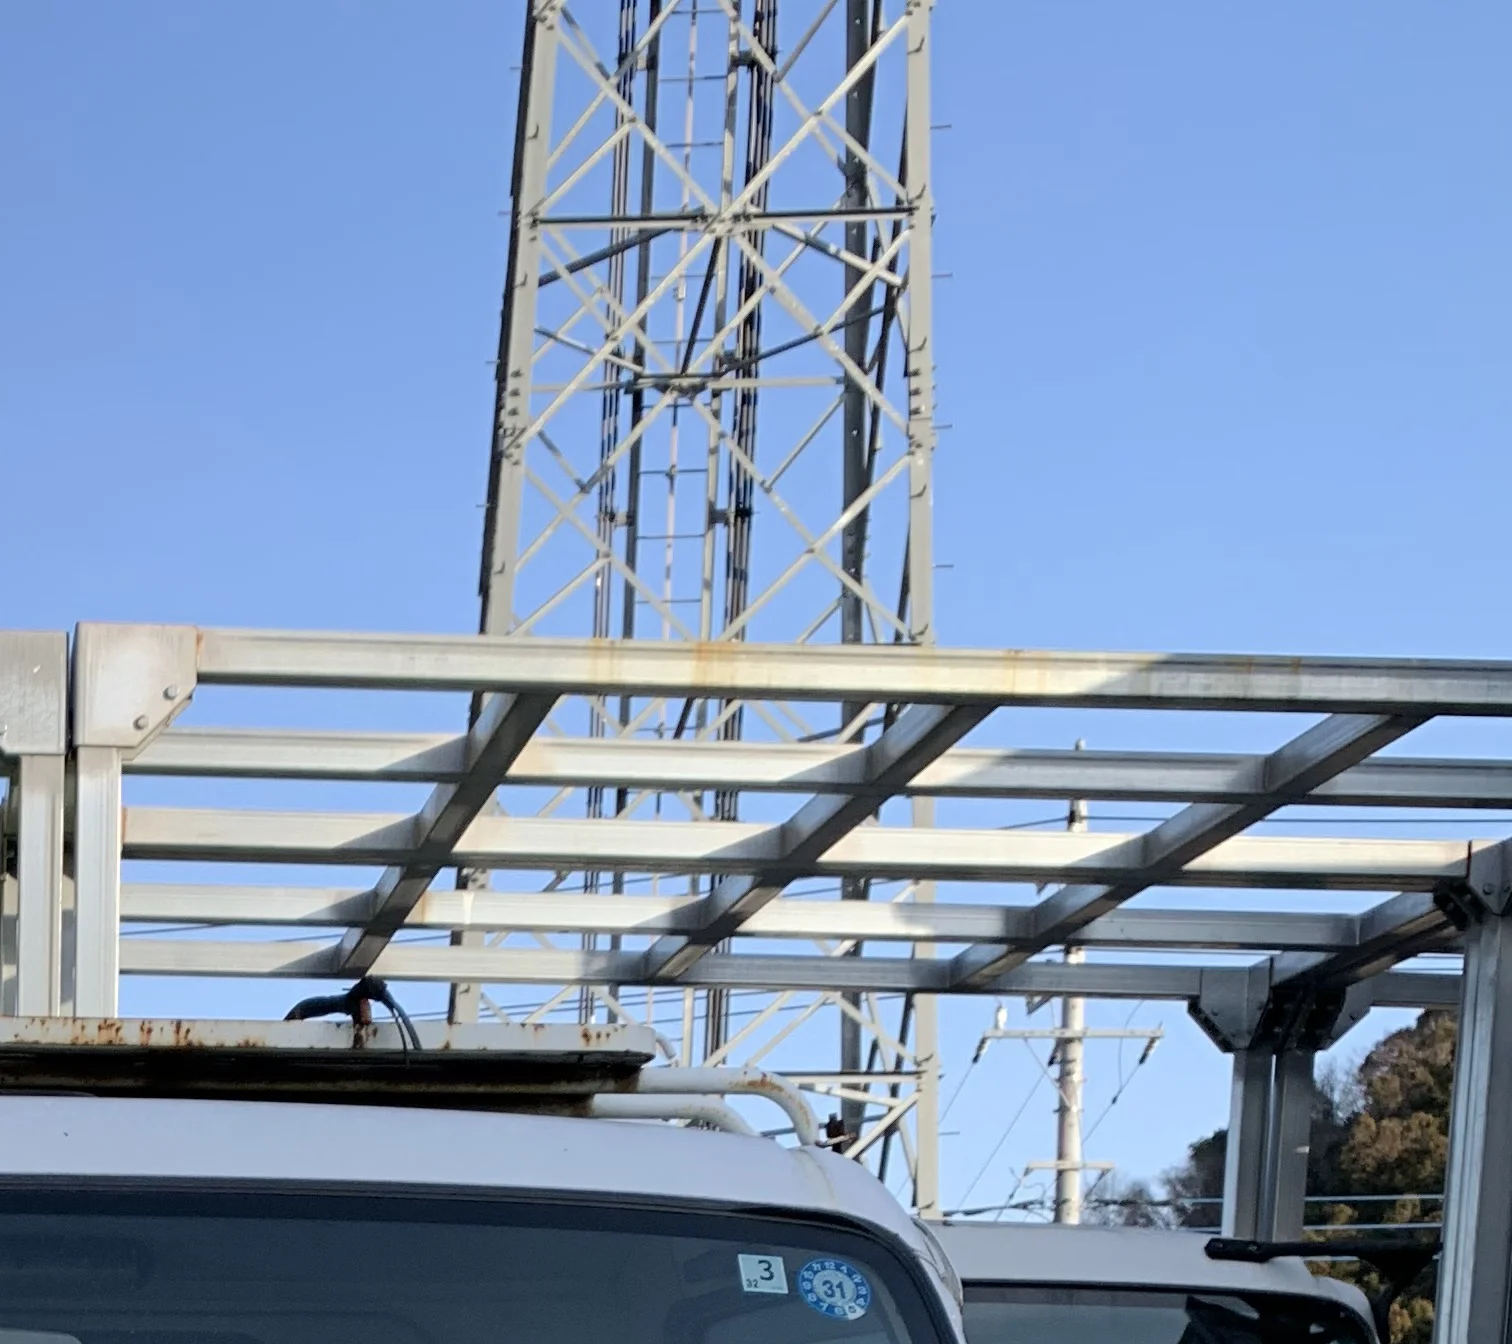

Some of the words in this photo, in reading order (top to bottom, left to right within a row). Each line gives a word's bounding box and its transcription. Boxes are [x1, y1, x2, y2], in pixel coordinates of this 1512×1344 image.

[757, 1259, 774, 1281] 3
[746, 1278, 759, 1288] 32
[822, 1279, 846, 1299] 31
